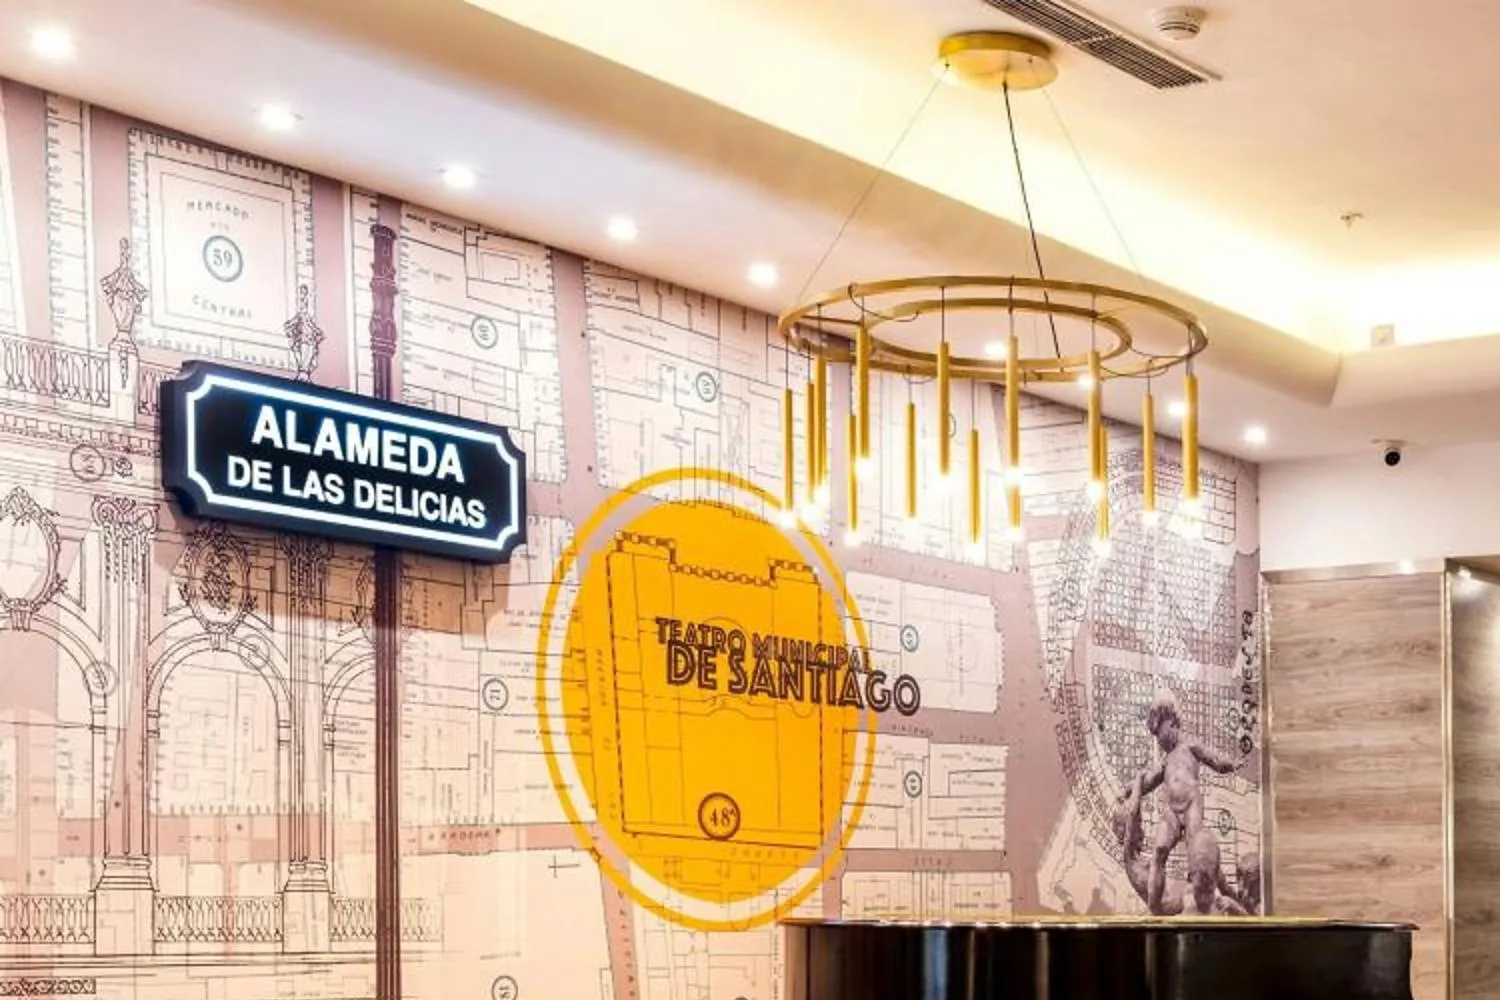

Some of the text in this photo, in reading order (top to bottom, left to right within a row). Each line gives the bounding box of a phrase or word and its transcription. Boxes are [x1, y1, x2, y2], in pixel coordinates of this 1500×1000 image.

[213, 247, 234, 269] 59
[251, 404, 465, 483] ALAMEDA
[227, 455, 486, 529] DE LAS DELICIAS
[655, 616, 747, 655] TEATRO
[751, 632, 872, 675] MUNICIPAL
[667, 640, 718, 691] DE
[728, 651, 921, 717] SANTIAGO
